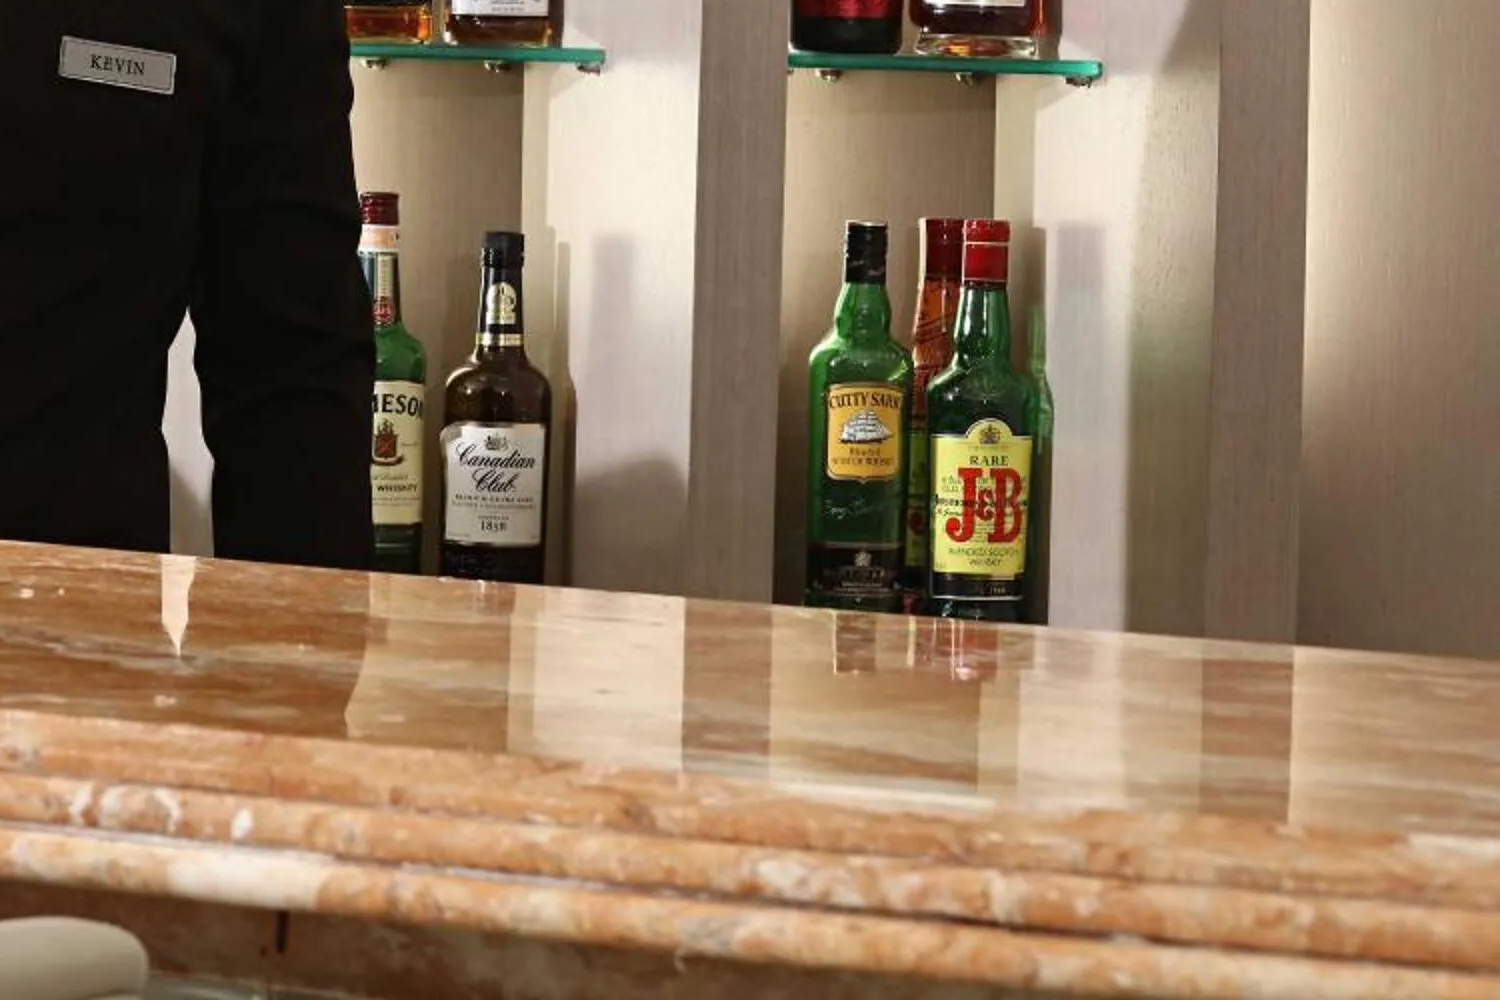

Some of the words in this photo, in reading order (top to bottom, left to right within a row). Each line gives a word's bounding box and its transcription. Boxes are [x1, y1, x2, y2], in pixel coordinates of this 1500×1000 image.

[90, 53, 145, 76] KEVIN
[456, 443, 536, 469] Canadian
[969, 455, 1008, 467] RARE
[472, 468, 519, 493] Club
